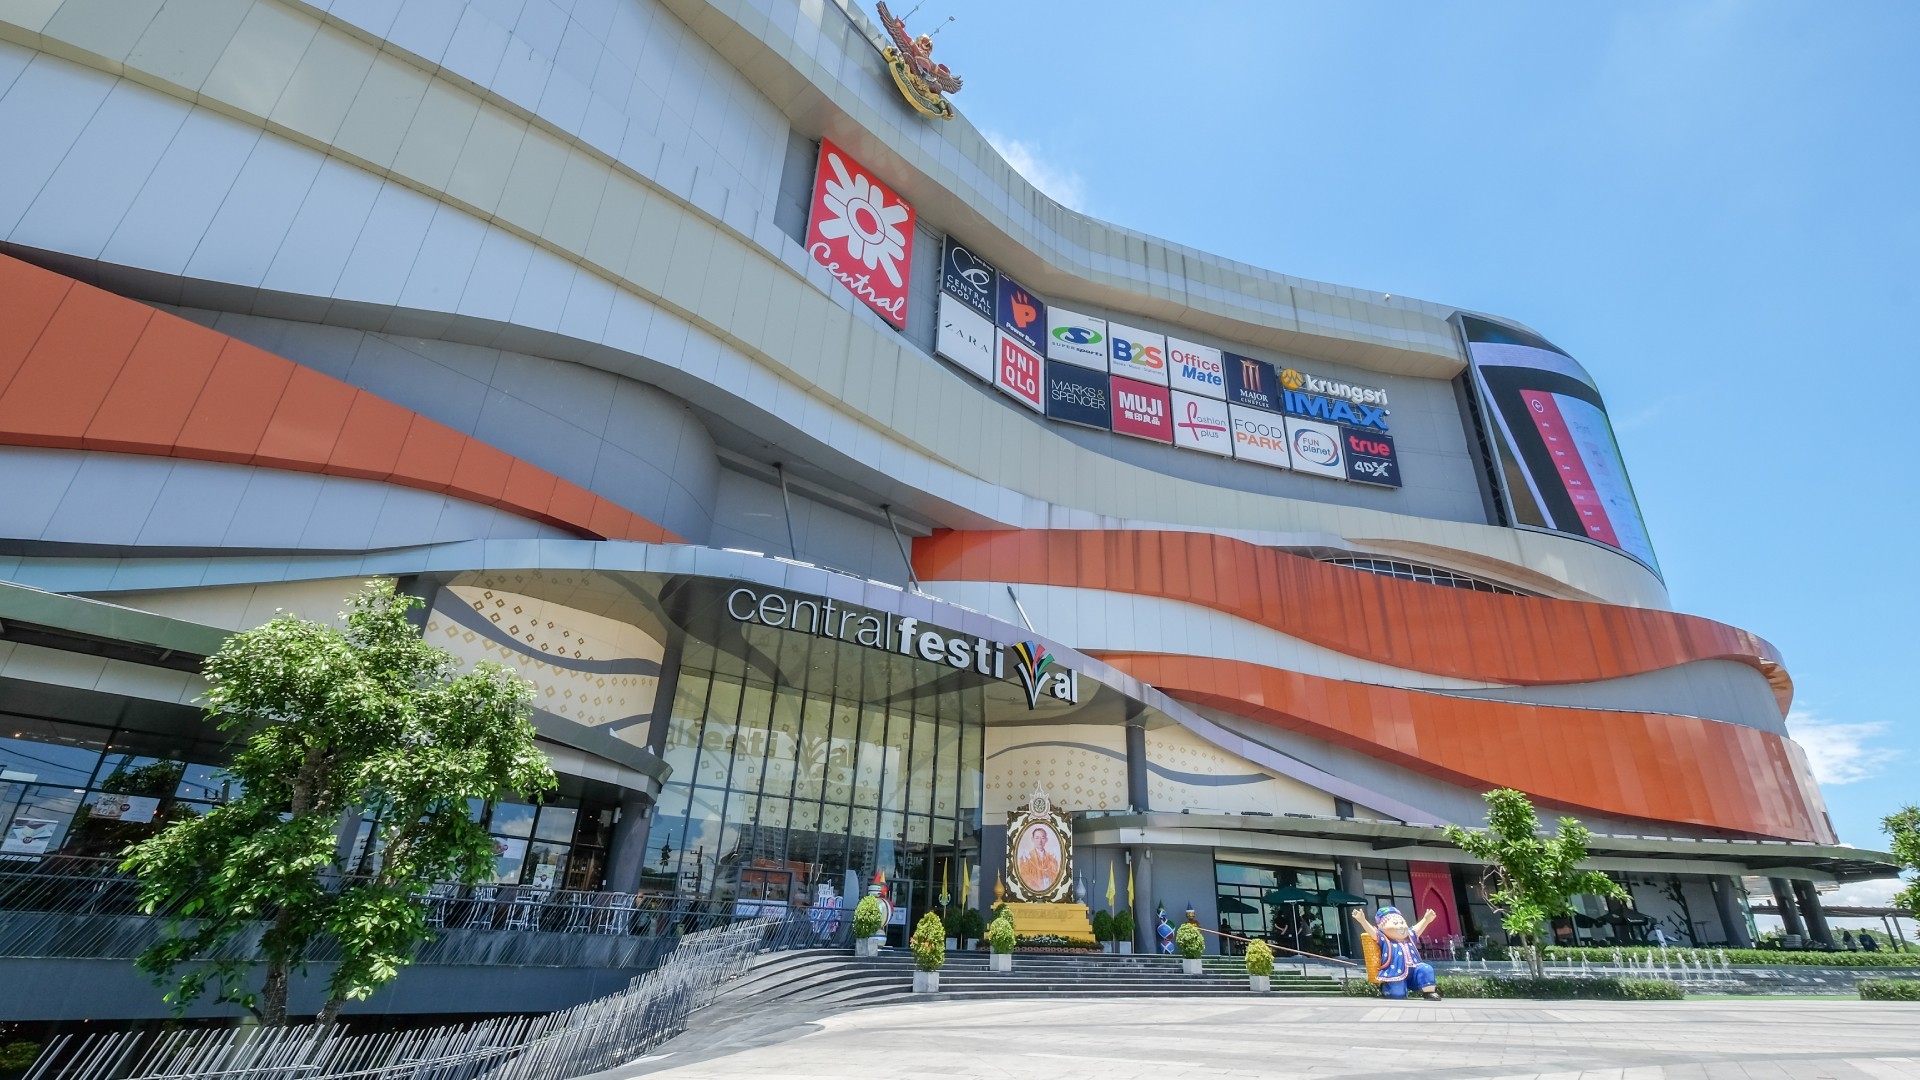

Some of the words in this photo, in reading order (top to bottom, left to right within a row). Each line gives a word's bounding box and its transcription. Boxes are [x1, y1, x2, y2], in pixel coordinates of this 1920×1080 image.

[809, 242, 905, 321] Central
[947, 275, 991, 309] CENTRAL
[946, 282, 970, 301] FOOD
[972, 298, 991, 316] HALL
[944, 321, 989, 354] ZARA
[1006, 321, 1024, 338] Power
[1024, 336, 1036, 347] Buy
[1006, 345, 1033, 376] UNI
[1112, 337, 1164, 369] B2S
[1171, 350, 1220, 373] Office
[1006, 365, 1035, 395] QLO
[1182, 365, 1222, 386] Mate
[1051, 389, 1106, 410] SPENCER
[1240, 389, 1269, 402] MAJOR
[1305, 374, 1389, 406] krungsri
[1118, 391, 1163, 417] MUJI
[1282, 389, 1390, 431] IMAX
[1200, 430, 1219, 439] plus
[1234, 418, 1282, 439] FOOD
[1236, 431, 1285, 452] PARK
[1302, 438, 1320, 447] FUN
[1302, 445, 1331, 457] planet
[1349, 435, 1391, 457] true
[1354, 461, 1390, 477] 4DX
